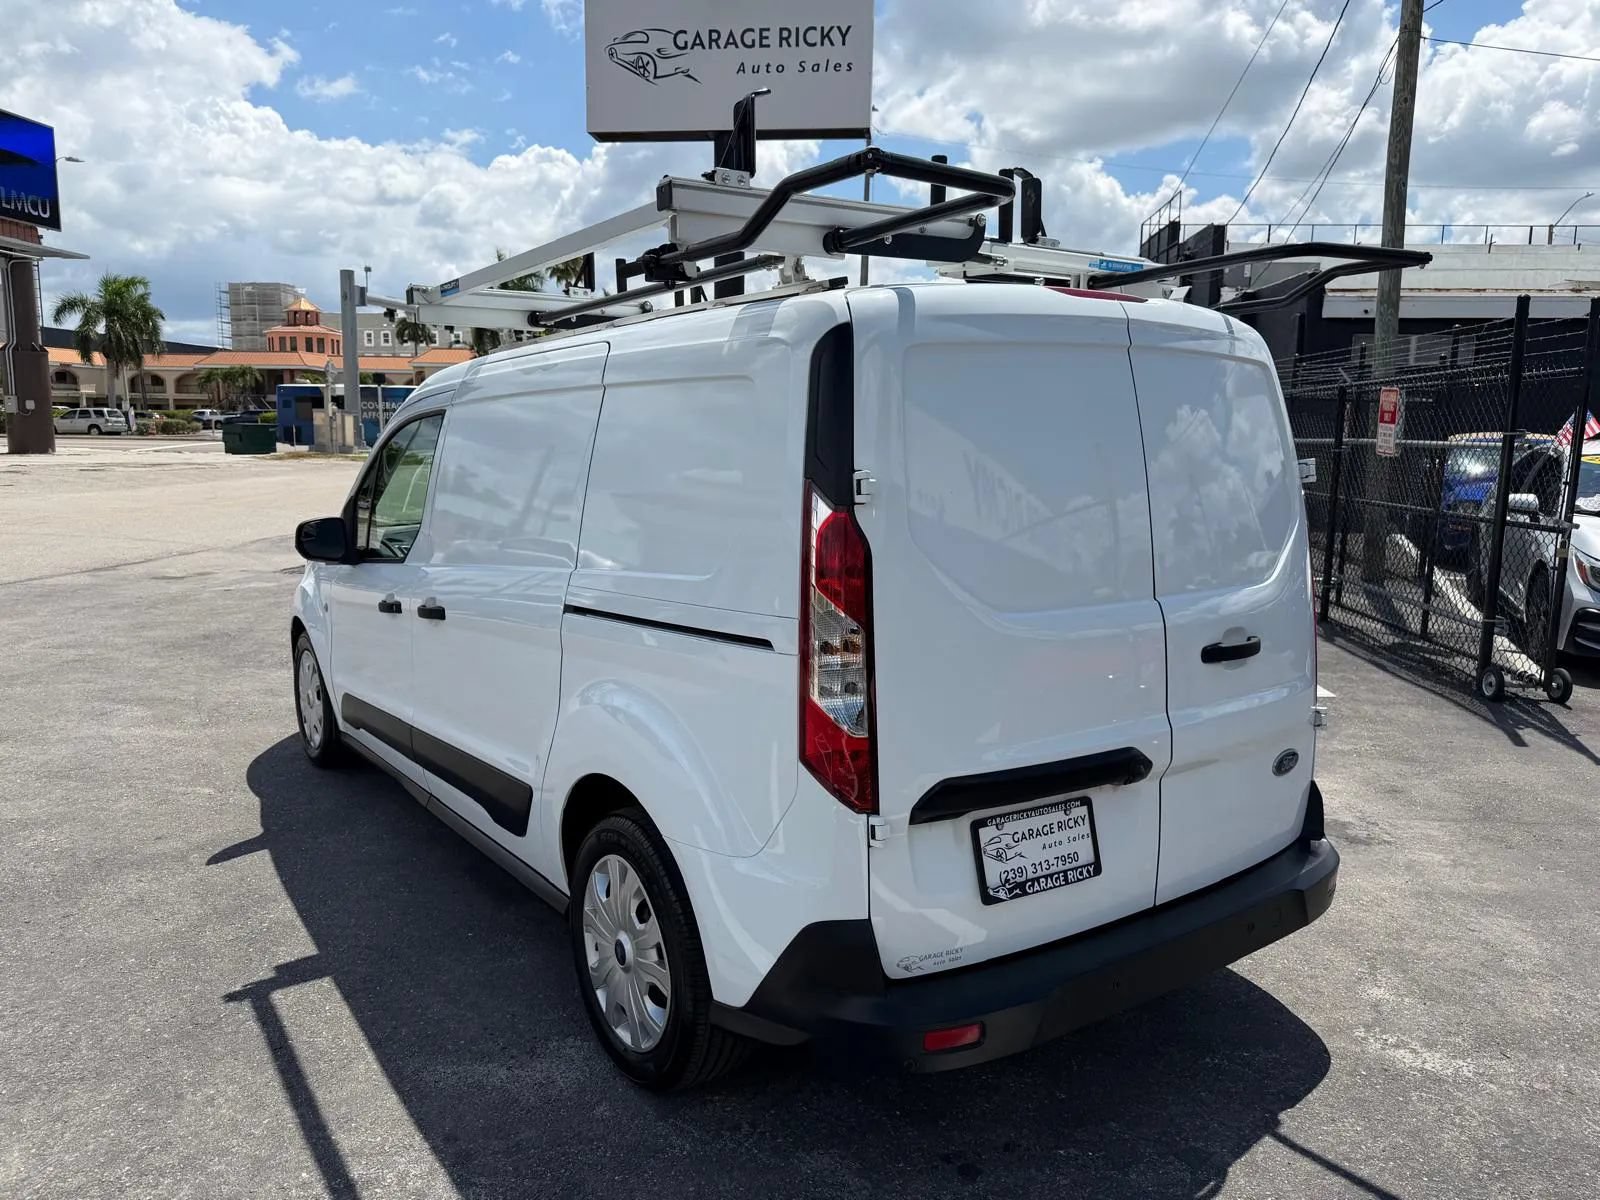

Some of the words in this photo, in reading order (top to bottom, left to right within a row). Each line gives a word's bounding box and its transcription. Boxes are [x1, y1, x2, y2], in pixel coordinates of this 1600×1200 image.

[673, 27, 771, 51] GARAGE
[778, 25, 853, 48] RICKY
[736, 61, 785, 75] Auto
[798, 58, 854, 73] Sales
[0, 186, 50, 218] LMCU
[987, 800, 1081, 826] GARAGERICKYAUTOSALES.COM
[1012, 822, 1055, 843] GARAGE
[1057, 814, 1087, 833] RICKY
[1042, 840, 1063, 850] Auto
[1067, 832, 1091, 844] Sales
[999, 865, 1028, 886] (239)
[1031, 851, 1080, 874] 313-7950
[1025, 873, 1066, 894] GARAGE
[1067, 865, 1095, 882] RICKY
[919, 951, 944, 962] GARAGE
